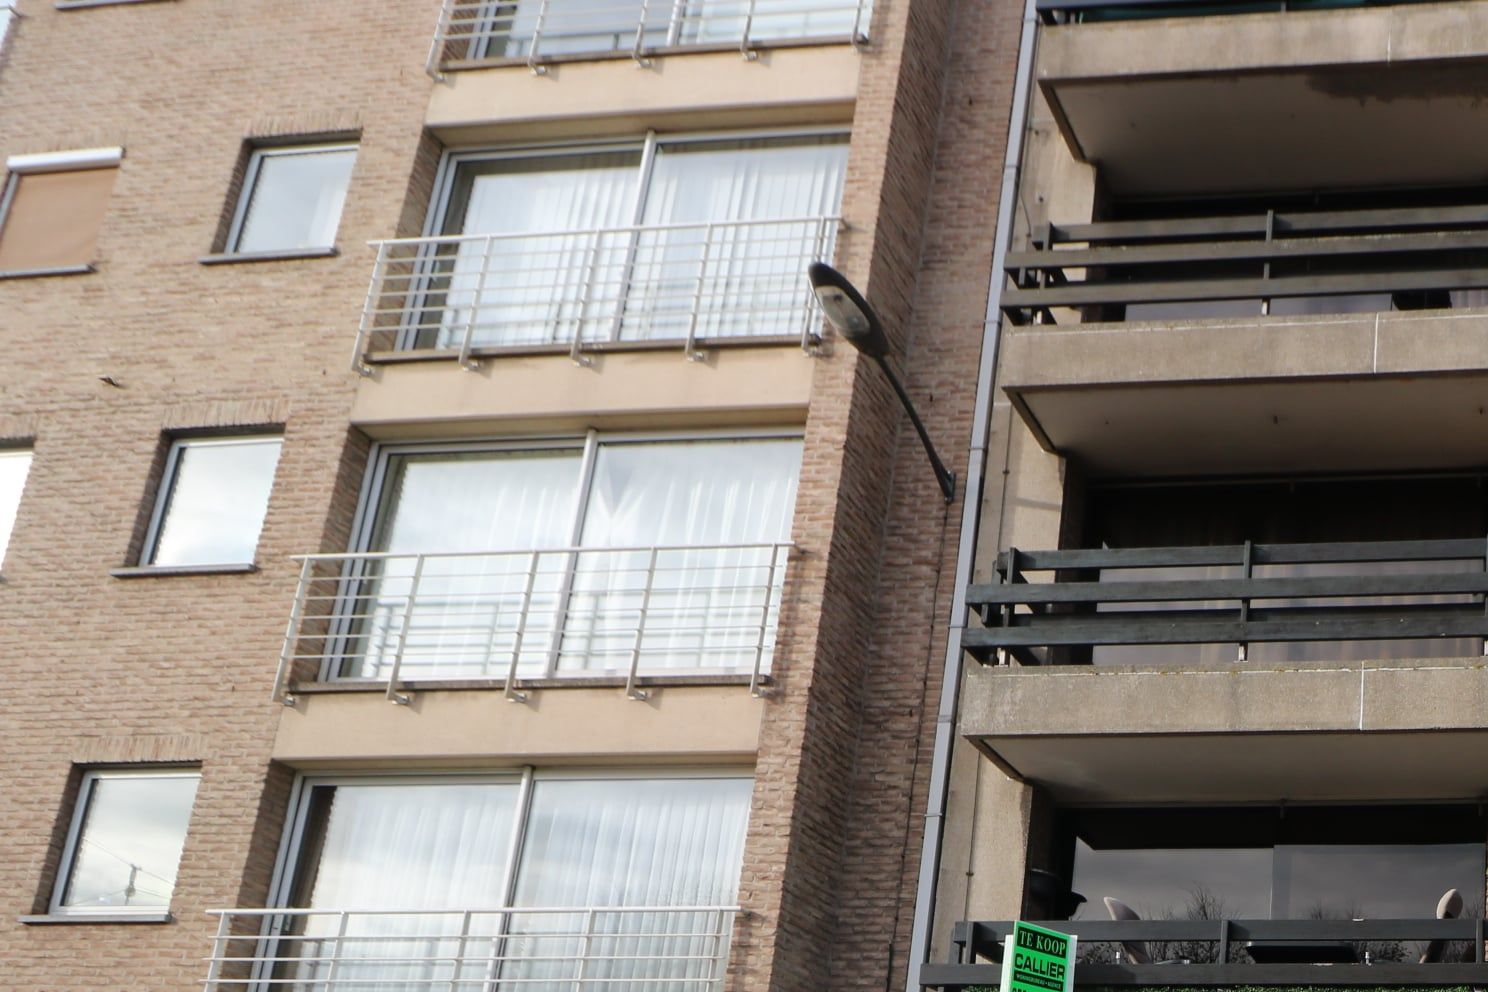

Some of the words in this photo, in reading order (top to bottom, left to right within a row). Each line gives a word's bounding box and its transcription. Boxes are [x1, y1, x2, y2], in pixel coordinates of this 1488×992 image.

[1019, 930, 1034, 947] TE
[1036, 935, 1066, 956] KOOP
[1014, 952, 1066, 981] CALLIER
